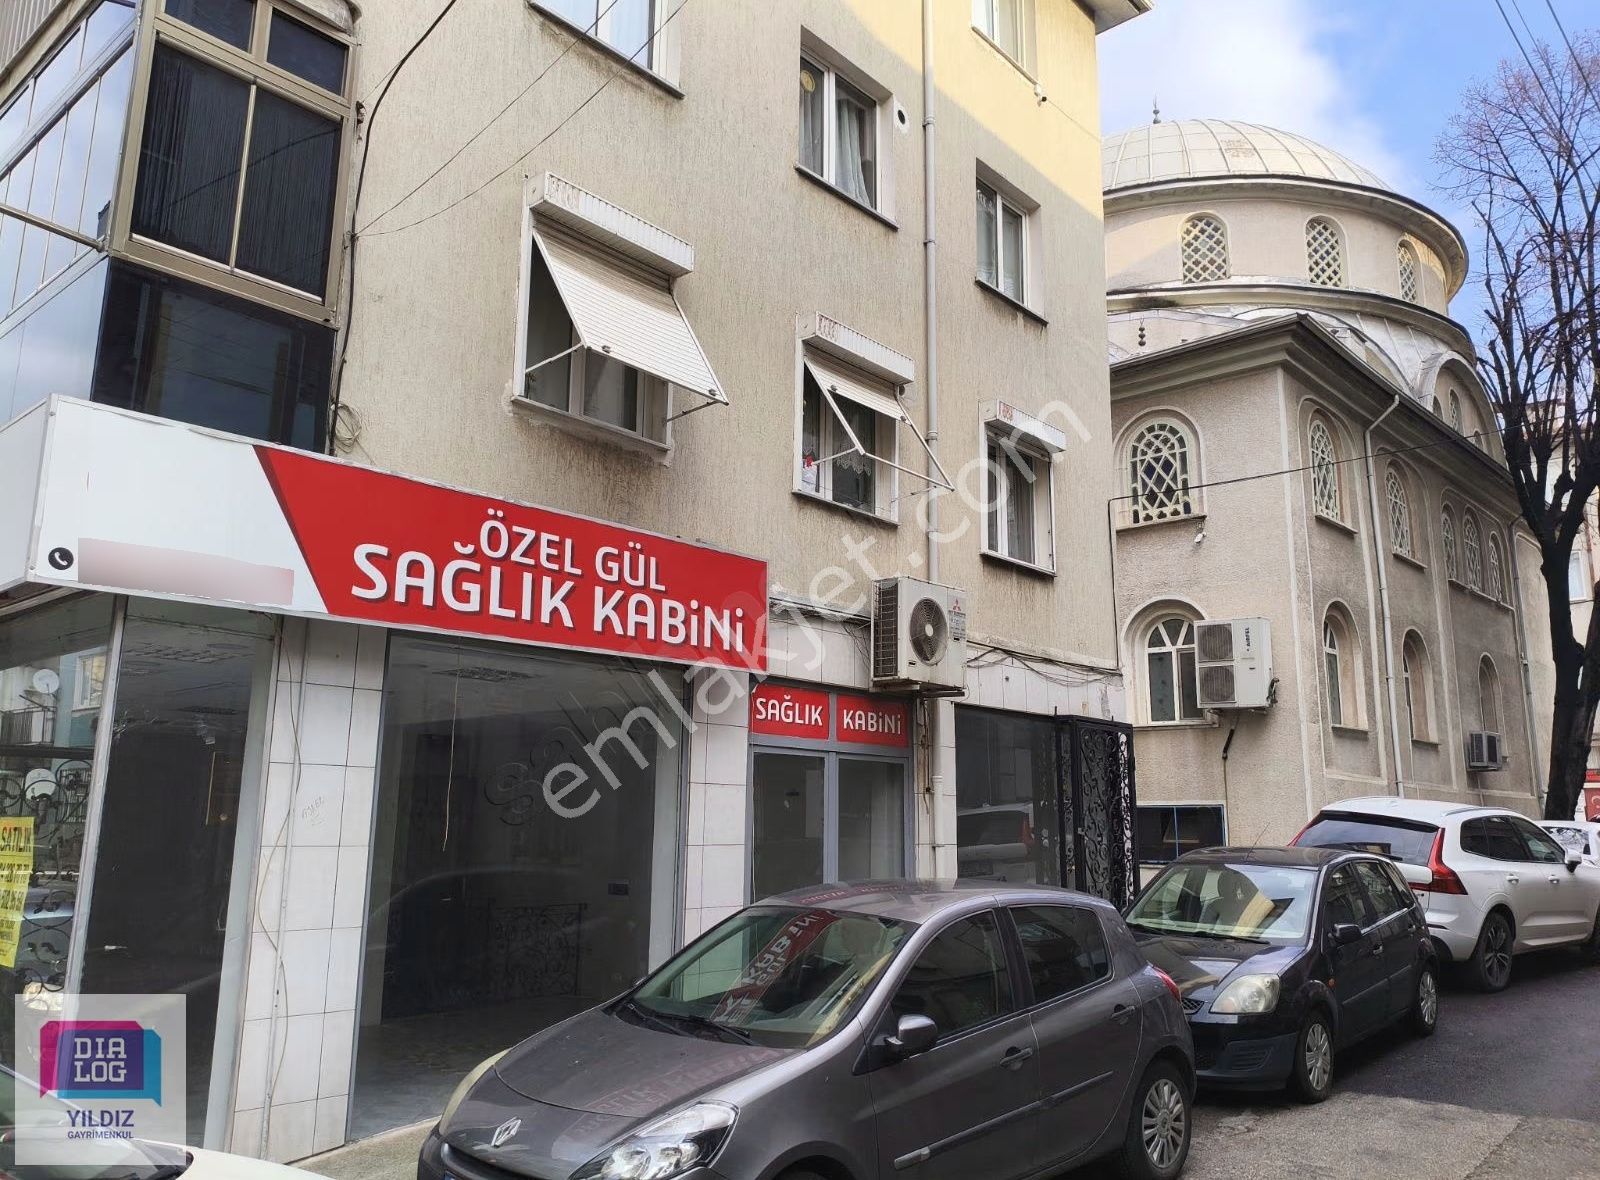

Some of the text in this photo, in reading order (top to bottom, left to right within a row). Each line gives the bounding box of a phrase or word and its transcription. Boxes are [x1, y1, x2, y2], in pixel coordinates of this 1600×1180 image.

[351, 541, 574, 628] SAĞLIK
[480, 508, 666, 591] ÖZEL GÜL
[755, 694, 823, 726] SAĞLIK
